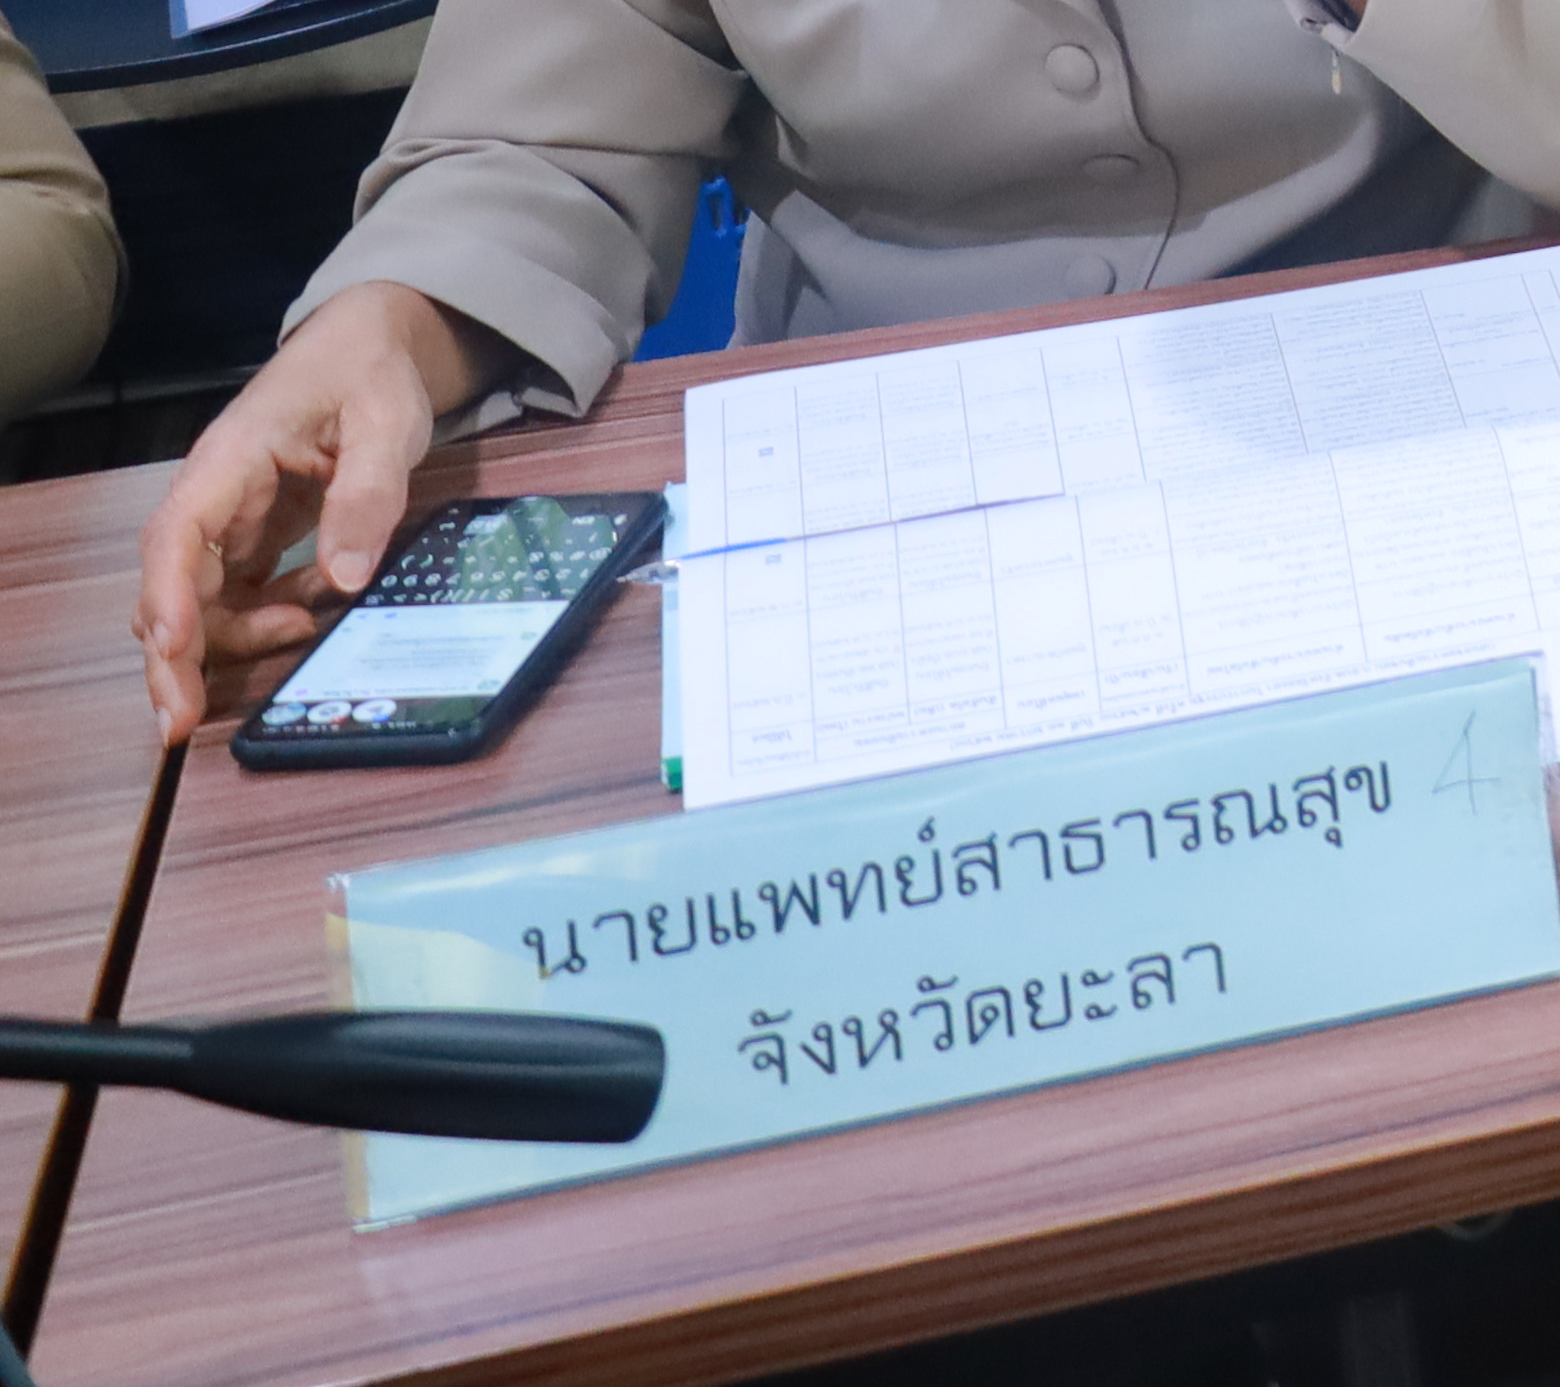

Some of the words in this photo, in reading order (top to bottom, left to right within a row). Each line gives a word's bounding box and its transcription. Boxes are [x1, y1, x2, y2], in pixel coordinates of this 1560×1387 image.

[1430, 707, 1503, 817] 4
[522, 760, 1395, 980] นายแพทย์สาธารณสุข
[737, 934, 1229, 1087] จังหวัดยะลา
